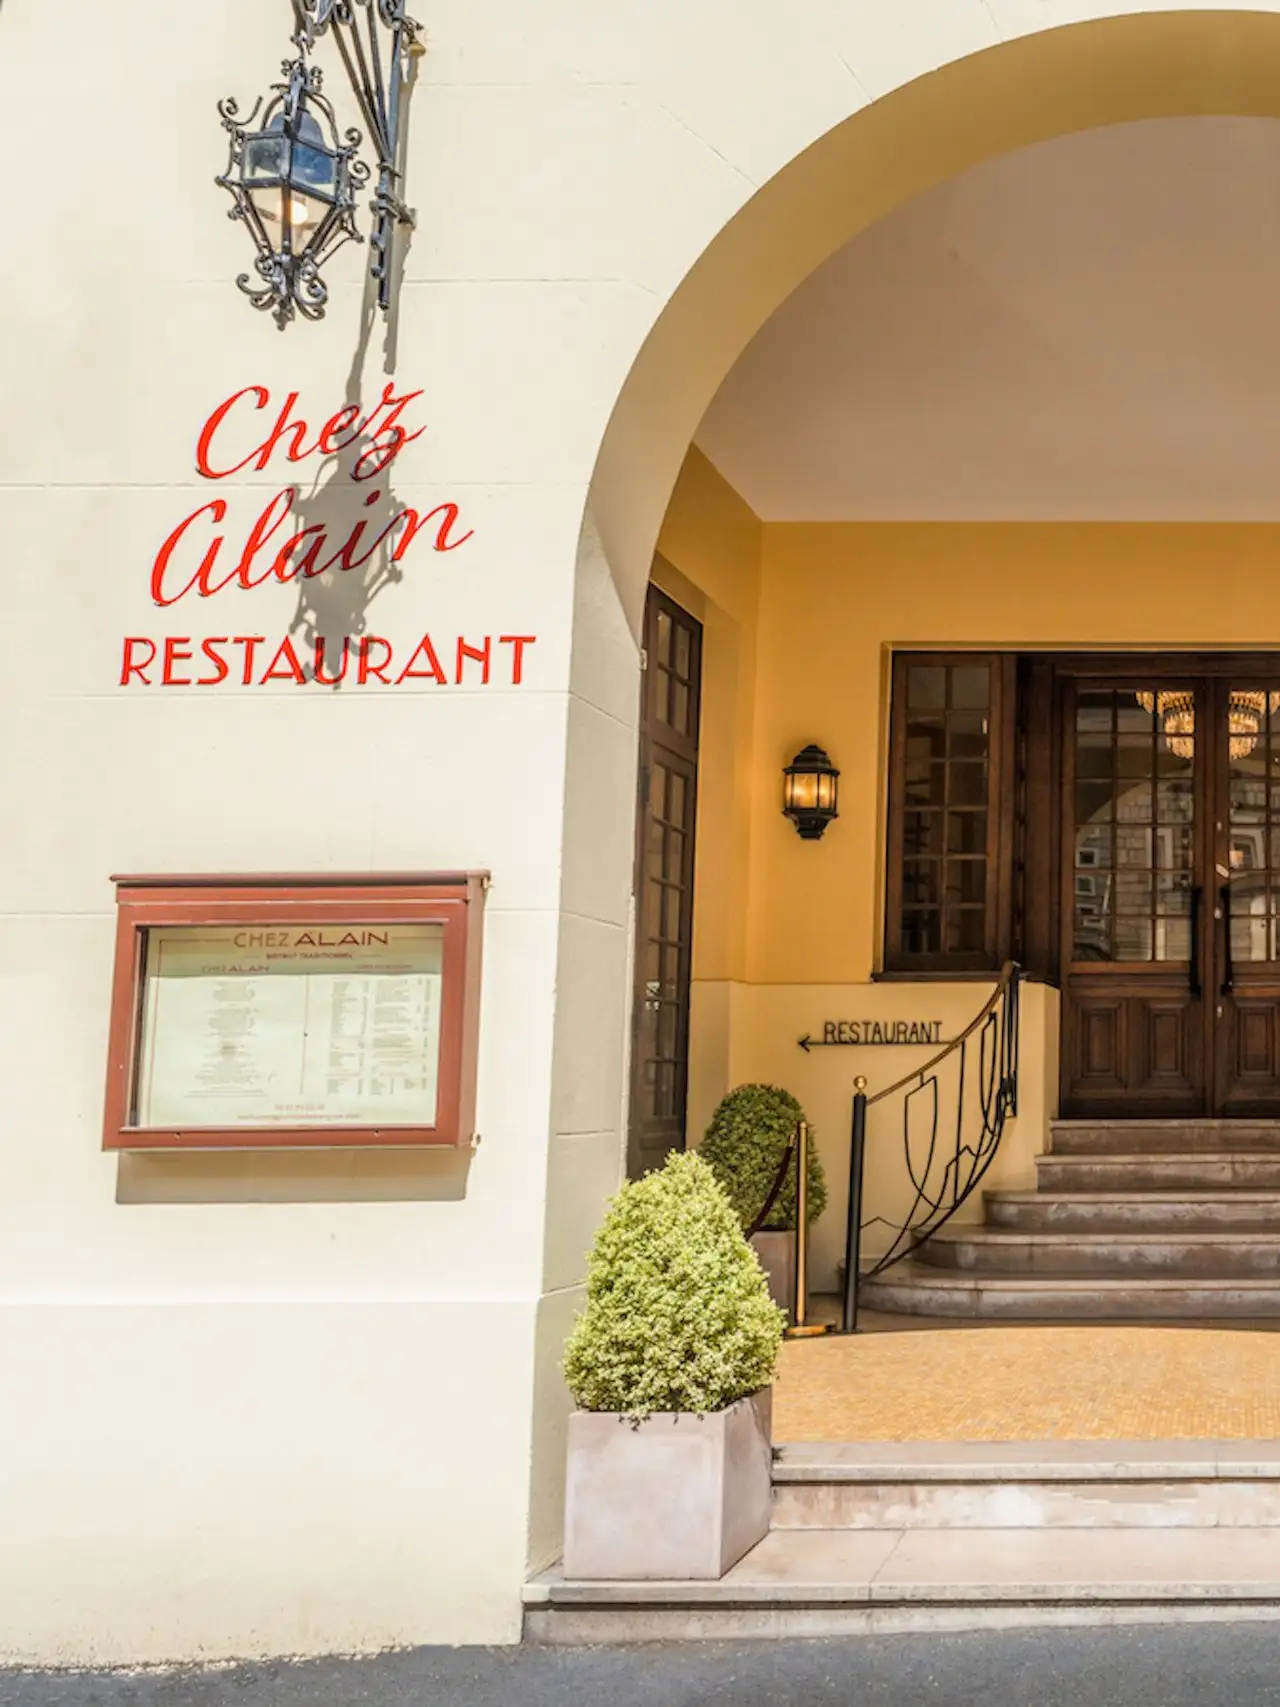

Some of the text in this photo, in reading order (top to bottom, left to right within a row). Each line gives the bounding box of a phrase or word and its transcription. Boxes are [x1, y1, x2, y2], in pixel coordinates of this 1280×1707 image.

[195, 382, 427, 480] Chez
[150, 487, 475, 606] Alain
[119, 633, 537, 686] RESTAURANT
[233, 931, 389, 947] CHEZ ALAIN
[824, 1020, 942, 1044] RESTAURANT
